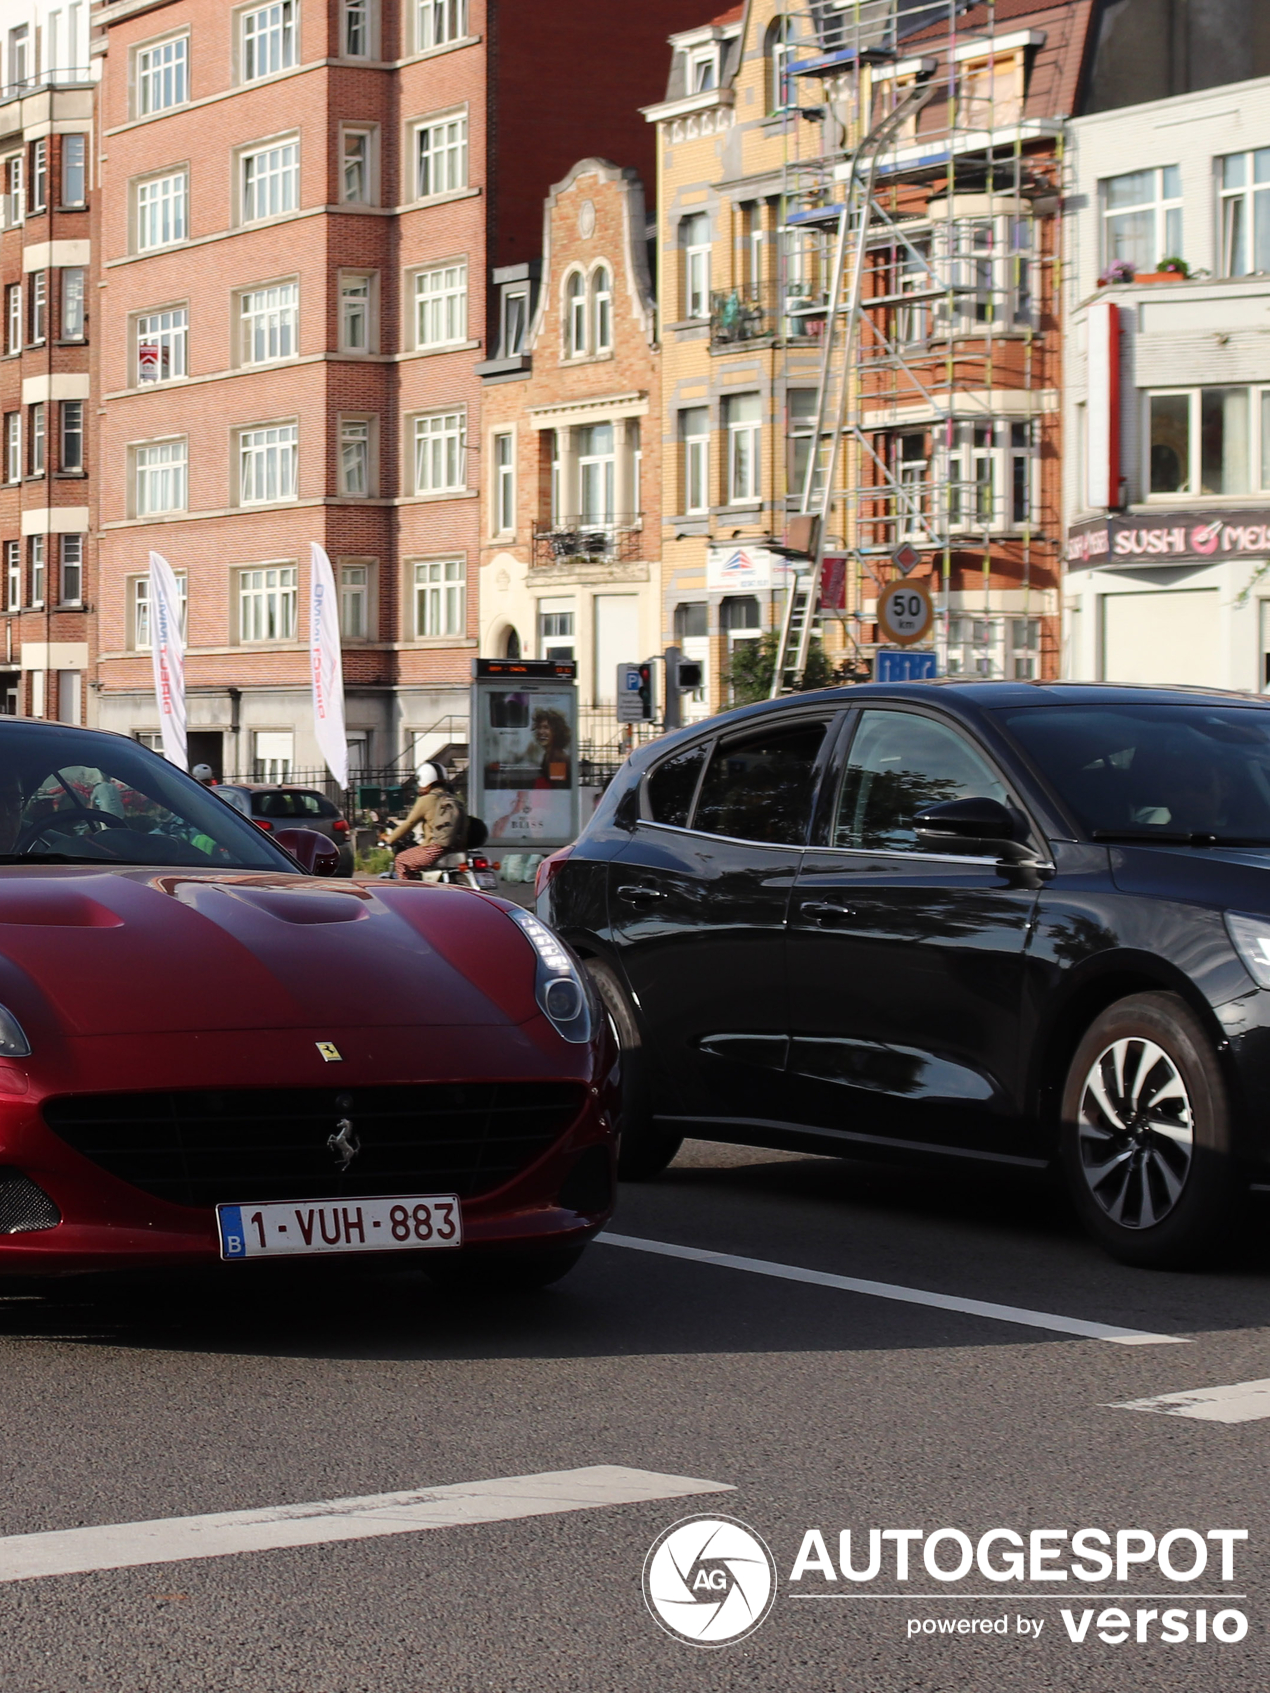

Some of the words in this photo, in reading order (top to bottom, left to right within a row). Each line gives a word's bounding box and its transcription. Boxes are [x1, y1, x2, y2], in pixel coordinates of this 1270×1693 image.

[1113, 527, 1186, 555] SUSHI
[893, 595, 921, 617] 50
[899, 619, 915, 629] km
[228, 1235, 242, 1253] B
[250, 1203, 457, 1248] 1-VUH-883
